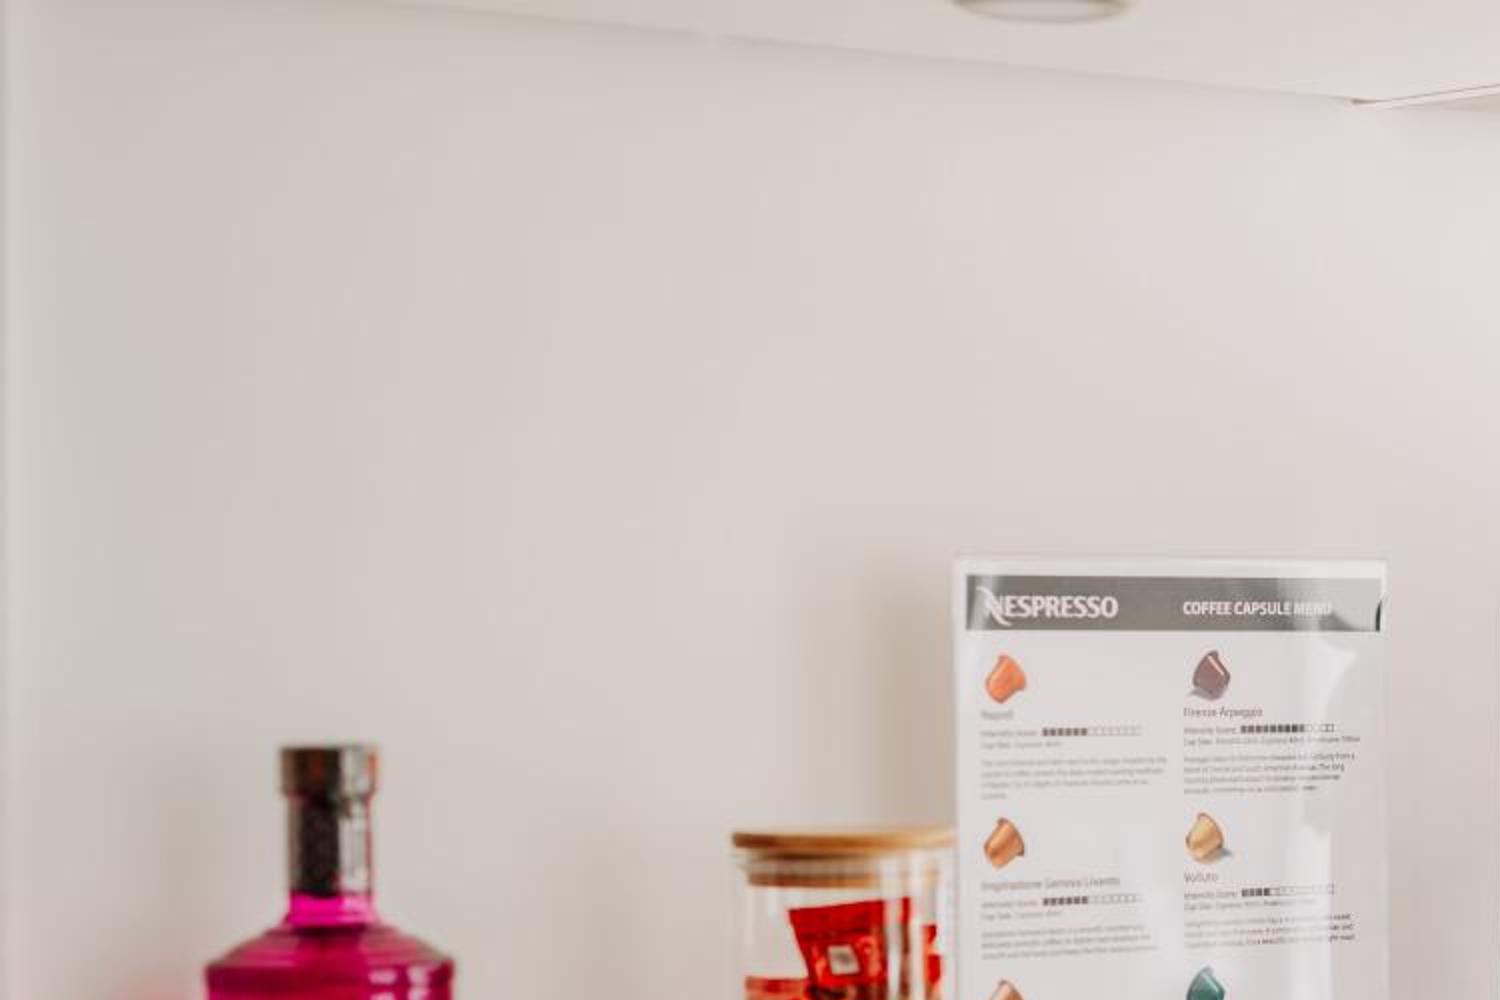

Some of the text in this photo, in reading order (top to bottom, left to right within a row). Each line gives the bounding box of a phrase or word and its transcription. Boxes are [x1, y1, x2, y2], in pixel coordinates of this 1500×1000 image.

[976, 585, 1119, 626] NESPRESSO
[1183, 601, 1233, 616] COFFEE
[1234, 600, 1292, 615] CAPSULE
